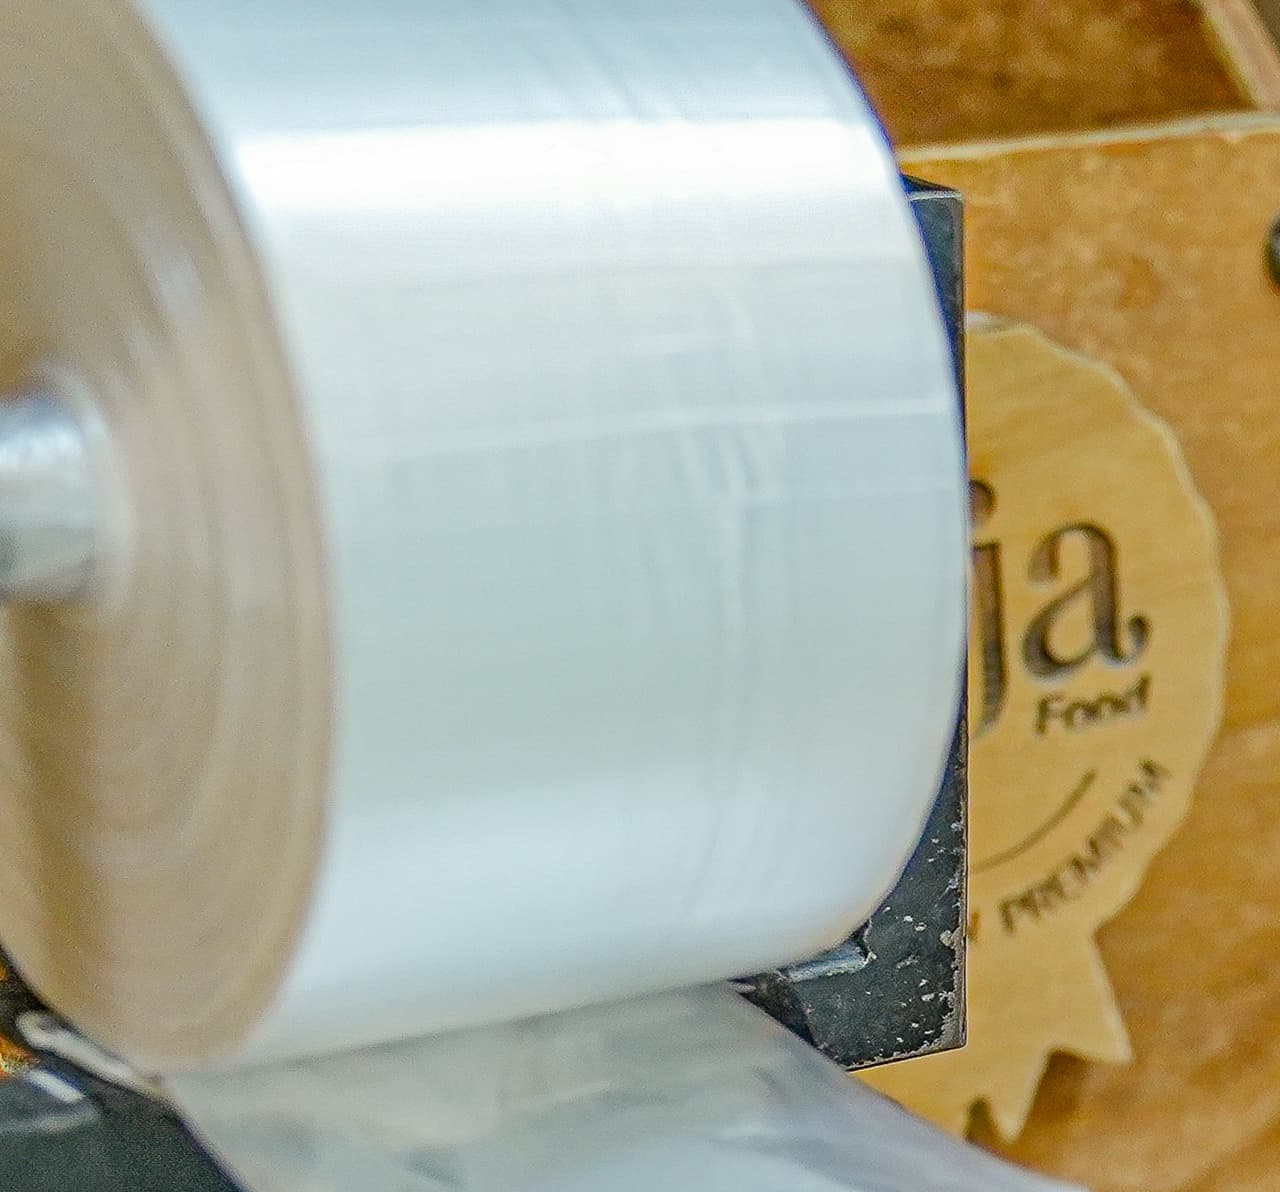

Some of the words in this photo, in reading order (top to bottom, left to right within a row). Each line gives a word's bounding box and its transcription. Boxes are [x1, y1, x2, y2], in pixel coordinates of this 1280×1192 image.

[968, 478, 1151, 738] ja
[1035, 670, 1151, 736] Food
[998, 758, 1172, 933] PREMIUM
